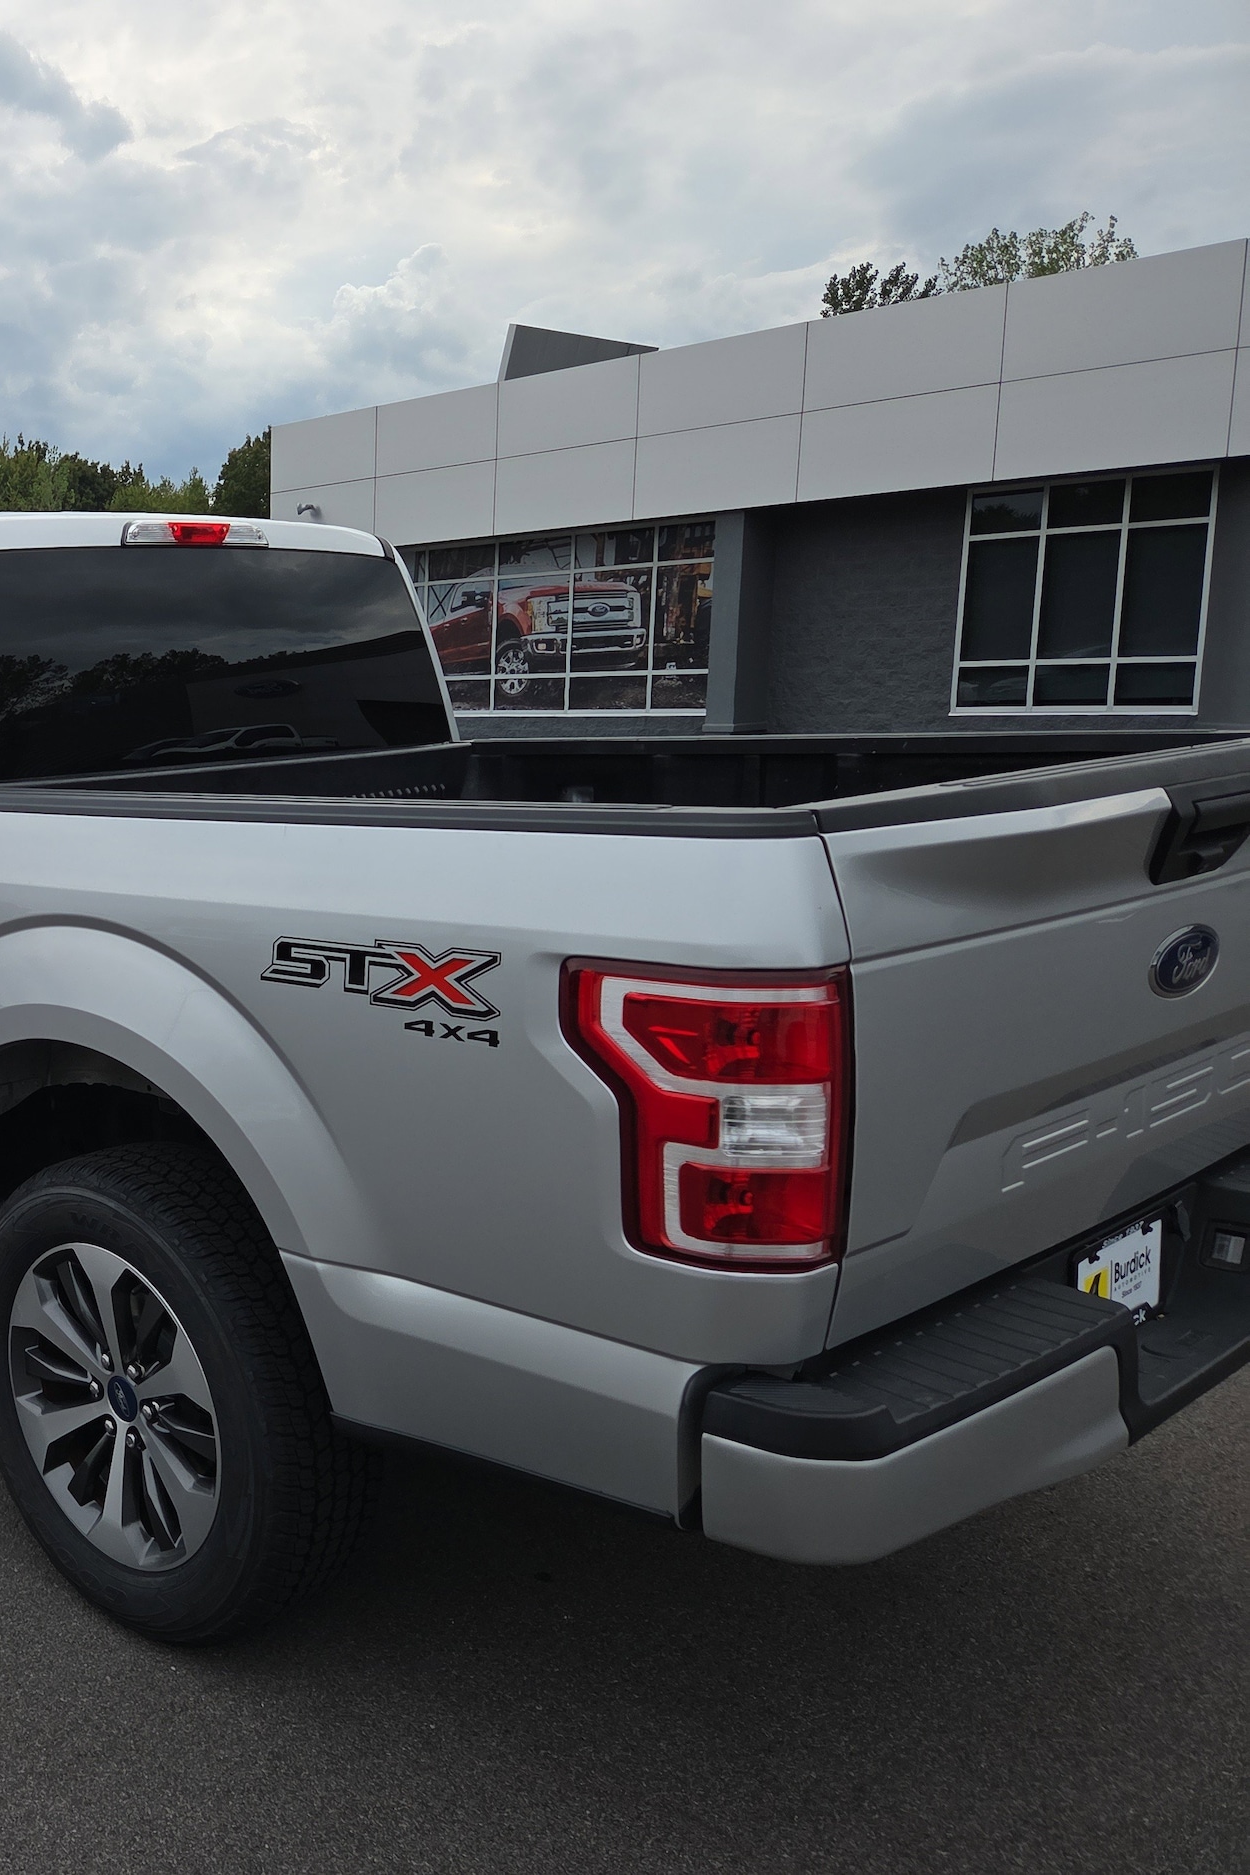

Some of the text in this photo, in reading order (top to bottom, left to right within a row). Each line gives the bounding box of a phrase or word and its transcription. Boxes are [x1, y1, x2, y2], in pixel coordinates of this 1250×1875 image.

[260, 936, 502, 1021] STX
[1171, 938, 1211, 984] Ford
[1114, 1245, 1152, 1284] Burdick
[1114, 1267, 1151, 1292] AUTOMOTIVE
